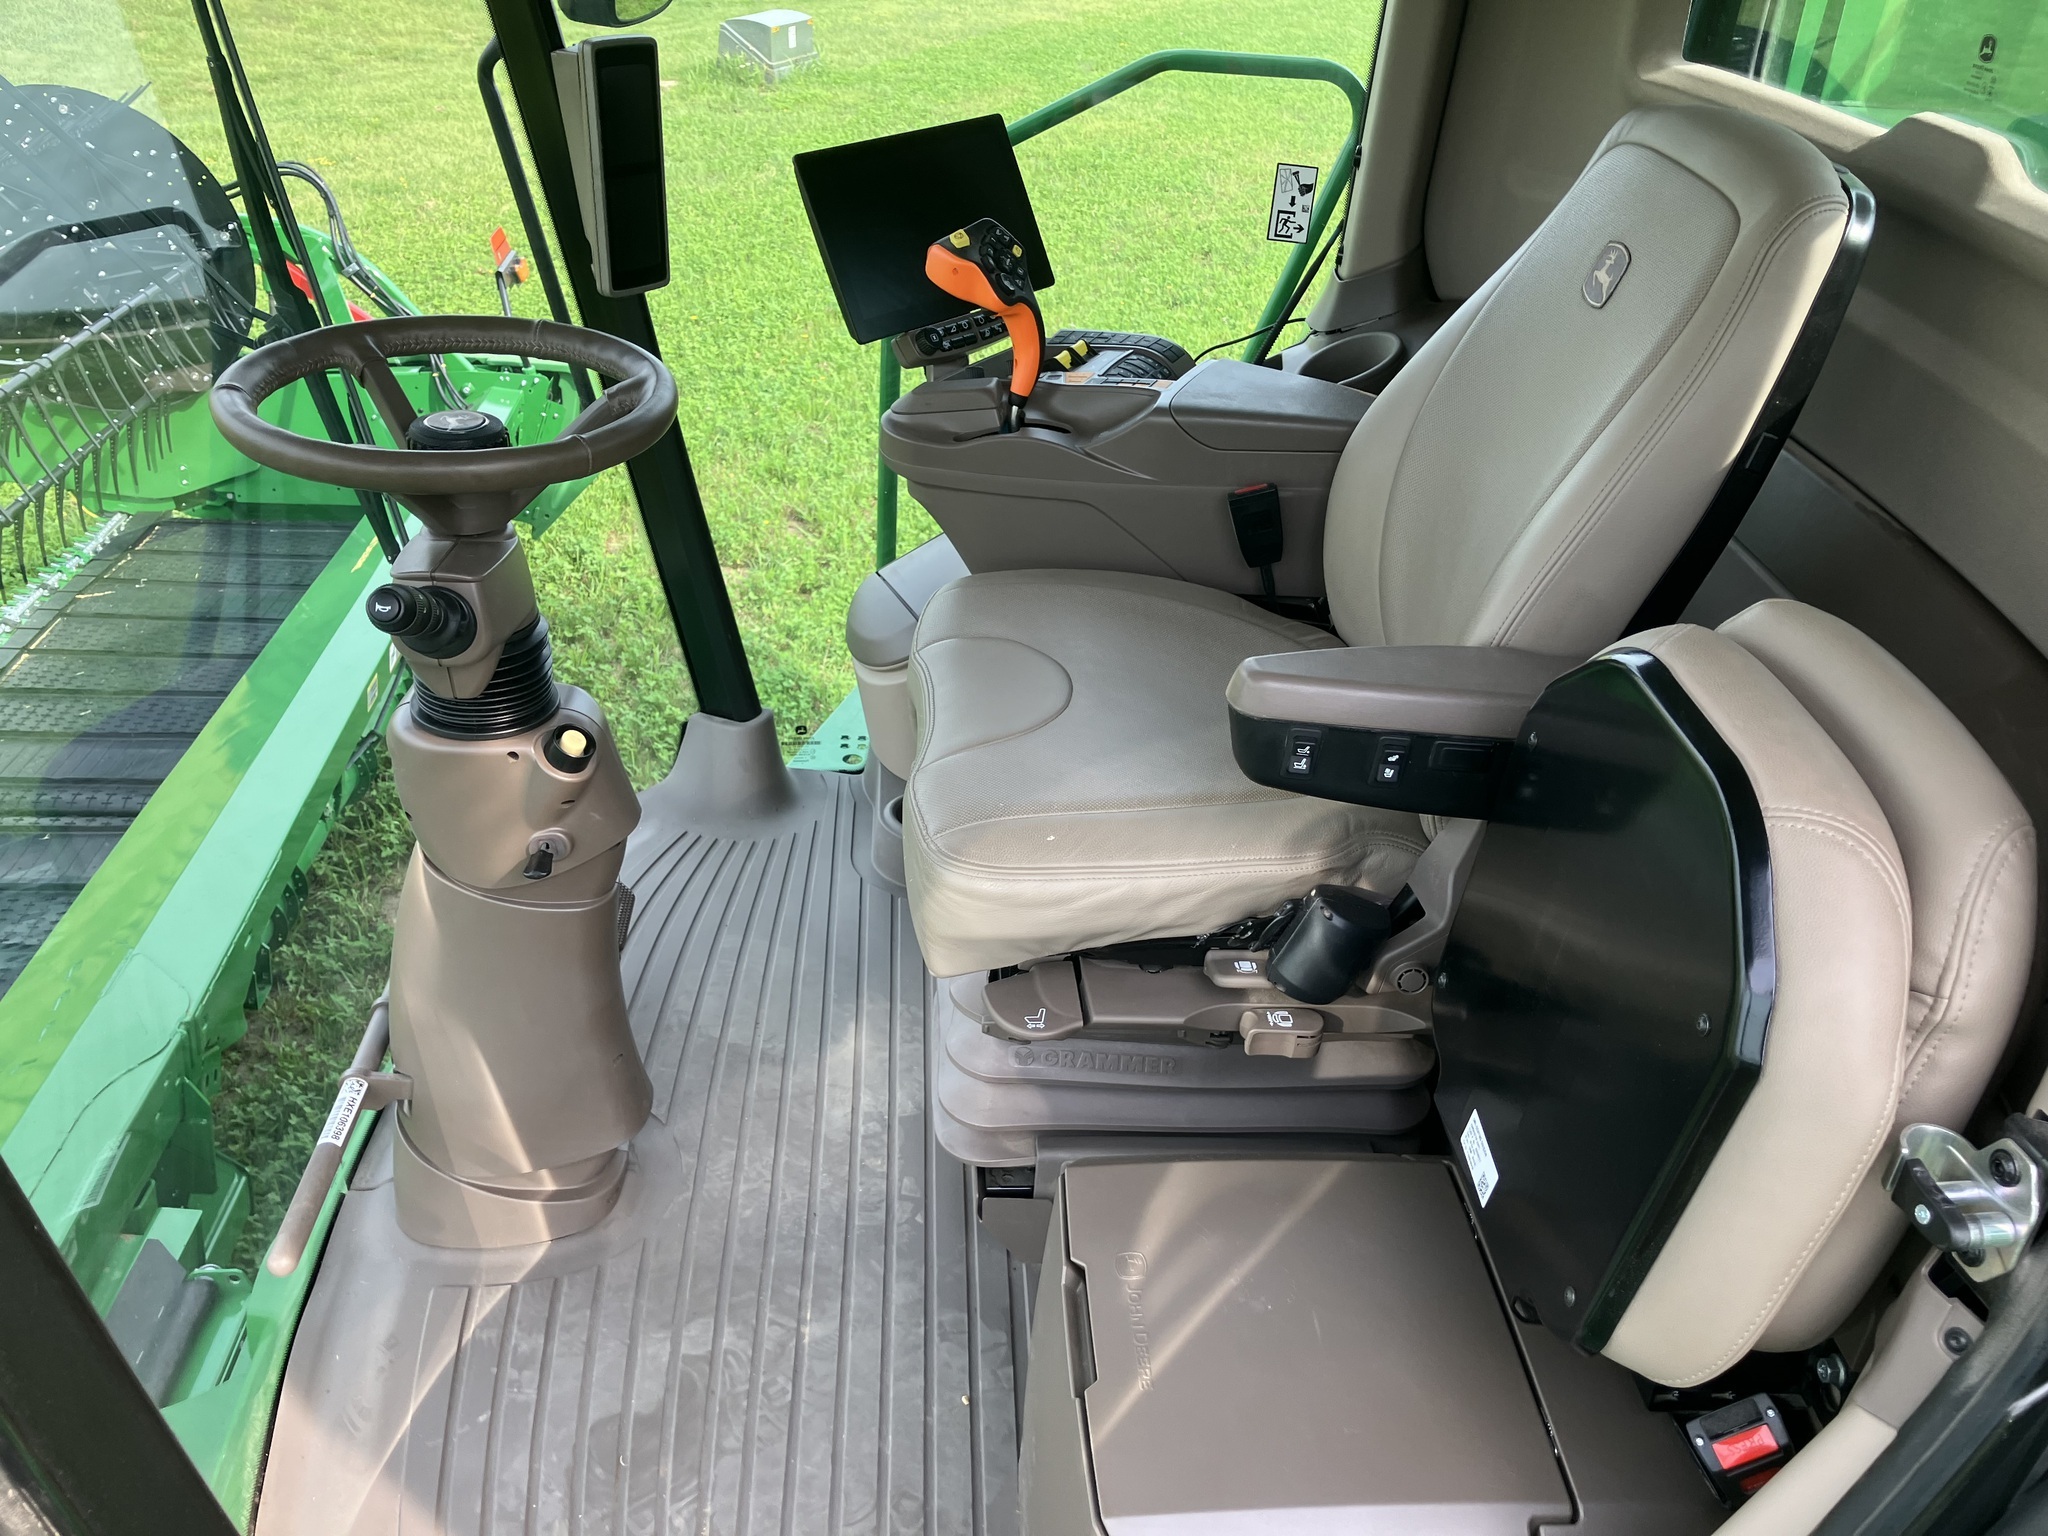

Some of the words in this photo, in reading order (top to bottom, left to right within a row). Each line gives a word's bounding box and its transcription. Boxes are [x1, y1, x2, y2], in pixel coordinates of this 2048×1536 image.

[1040, 1049, 1177, 1075] GRAMMER
[331, 1096, 358, 1141] HXE106398
[1126, 1284, 1144, 1329] JOHN
[1133, 1331, 1154, 1391] DEERE
[1726, 1433, 1765, 1457] PRESS
